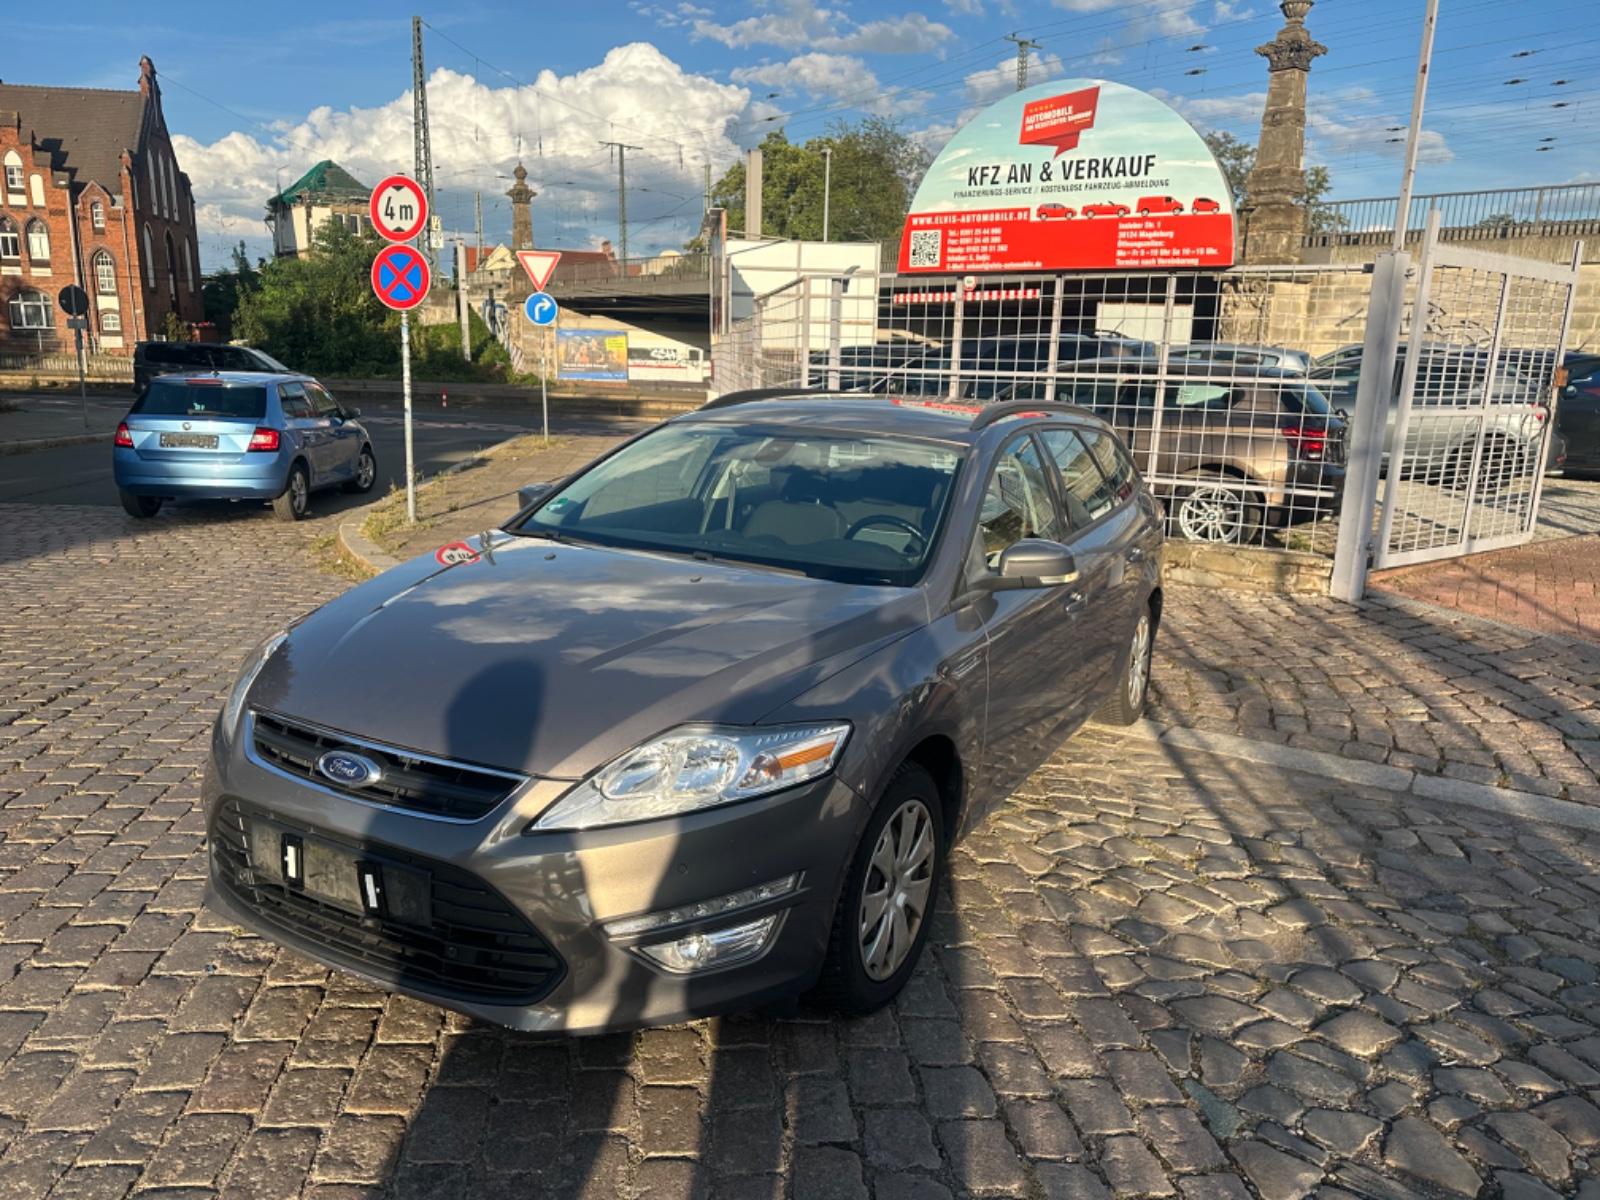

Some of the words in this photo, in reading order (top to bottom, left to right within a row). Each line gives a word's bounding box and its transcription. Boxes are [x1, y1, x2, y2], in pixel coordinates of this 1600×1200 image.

[1025, 105, 1073, 124] AUTOMOBILE
[967, 164, 1000, 187] KFZ
[1007, 163, 1032, 184] AN
[1039, 161, 1053, 182] &
[1061, 154, 1157, 180] VERKAUF
[953, 186, 1033, 199] FINANZIERUNGS-SERVICE
[1040, 183, 1083, 194] KOSTENLOSE
[1084, 179, 1170, 192] FAHRZEUG-ABMELDUNG
[384, 196, 395, 220] 4
[399, 204, 414, 220] m
[912, 211, 1029, 226] WWW.ELVIS-AUTOMOBILE.DE
[1139, 230, 1174, 239] Magdeburg
[329, 758, 359, 777] Ford
